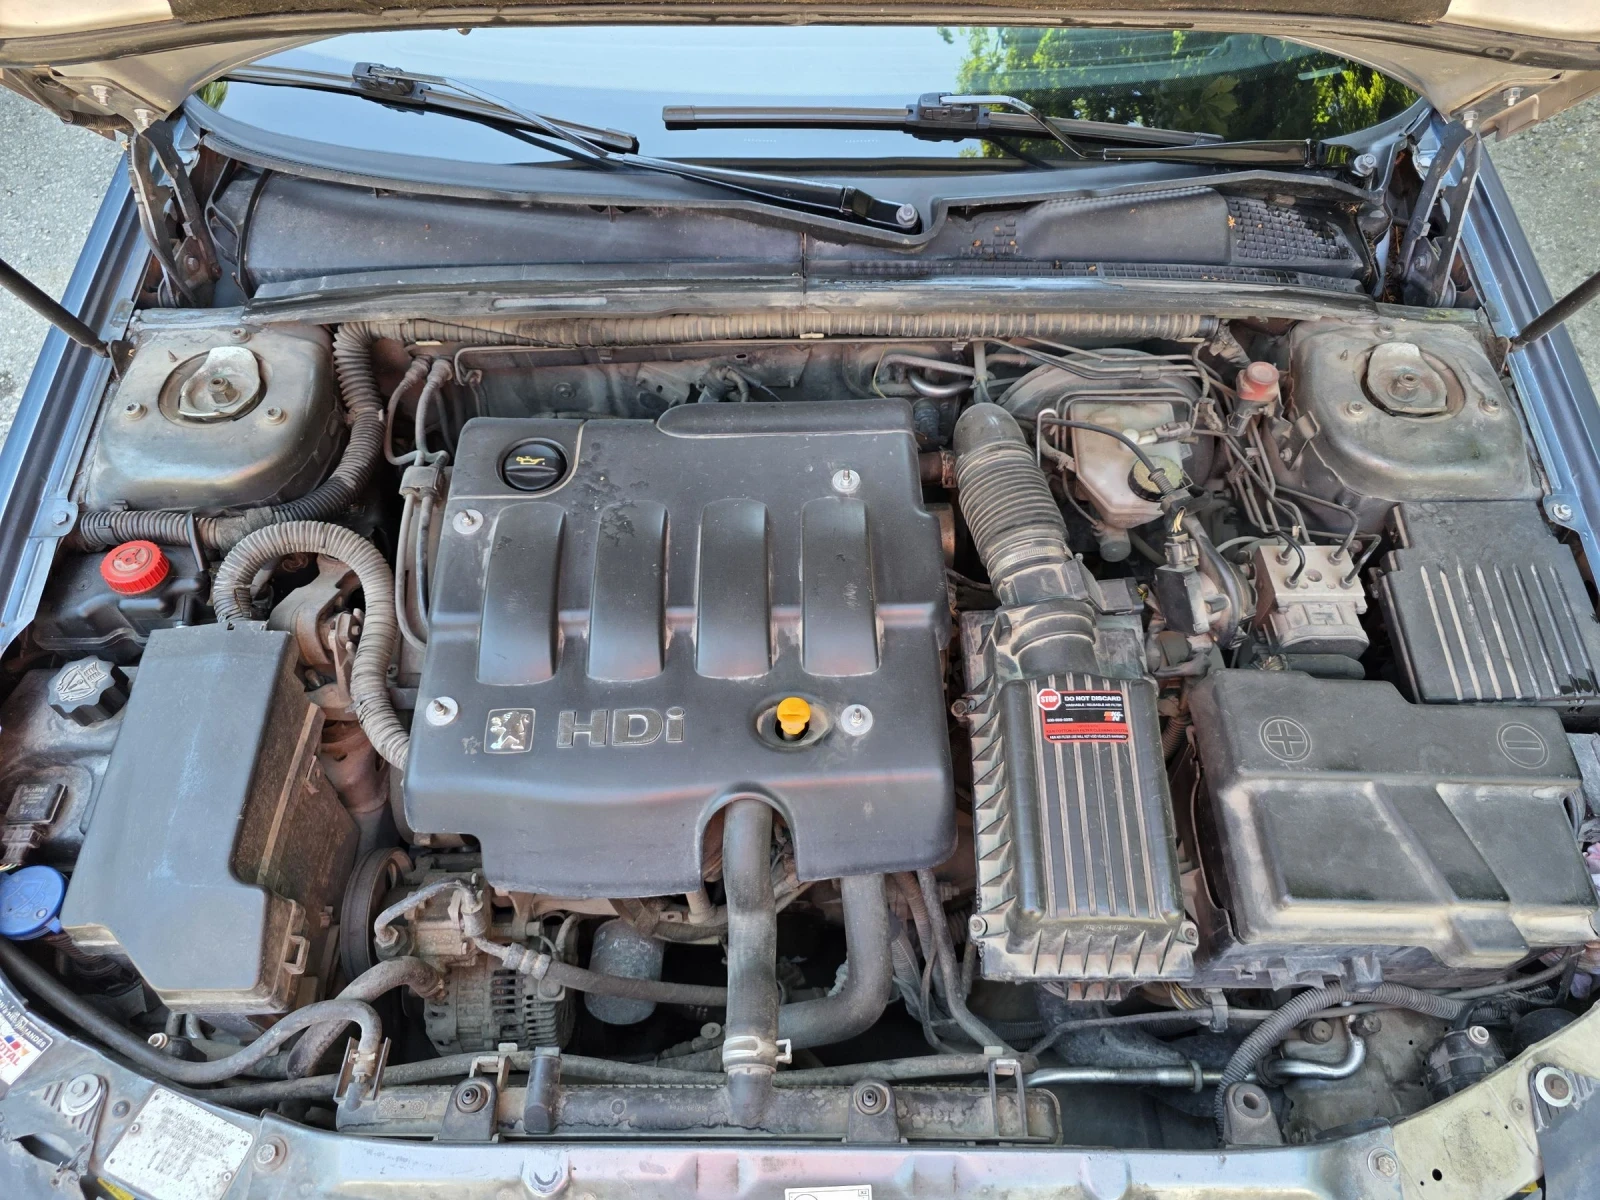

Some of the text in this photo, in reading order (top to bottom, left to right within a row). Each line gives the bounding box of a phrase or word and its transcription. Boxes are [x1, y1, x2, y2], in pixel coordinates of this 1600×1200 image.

[1041, 695, 1057, 703] STOP
[556, 706, 685, 748] HDi
[0, 1038, 20, 1066] OTAL
